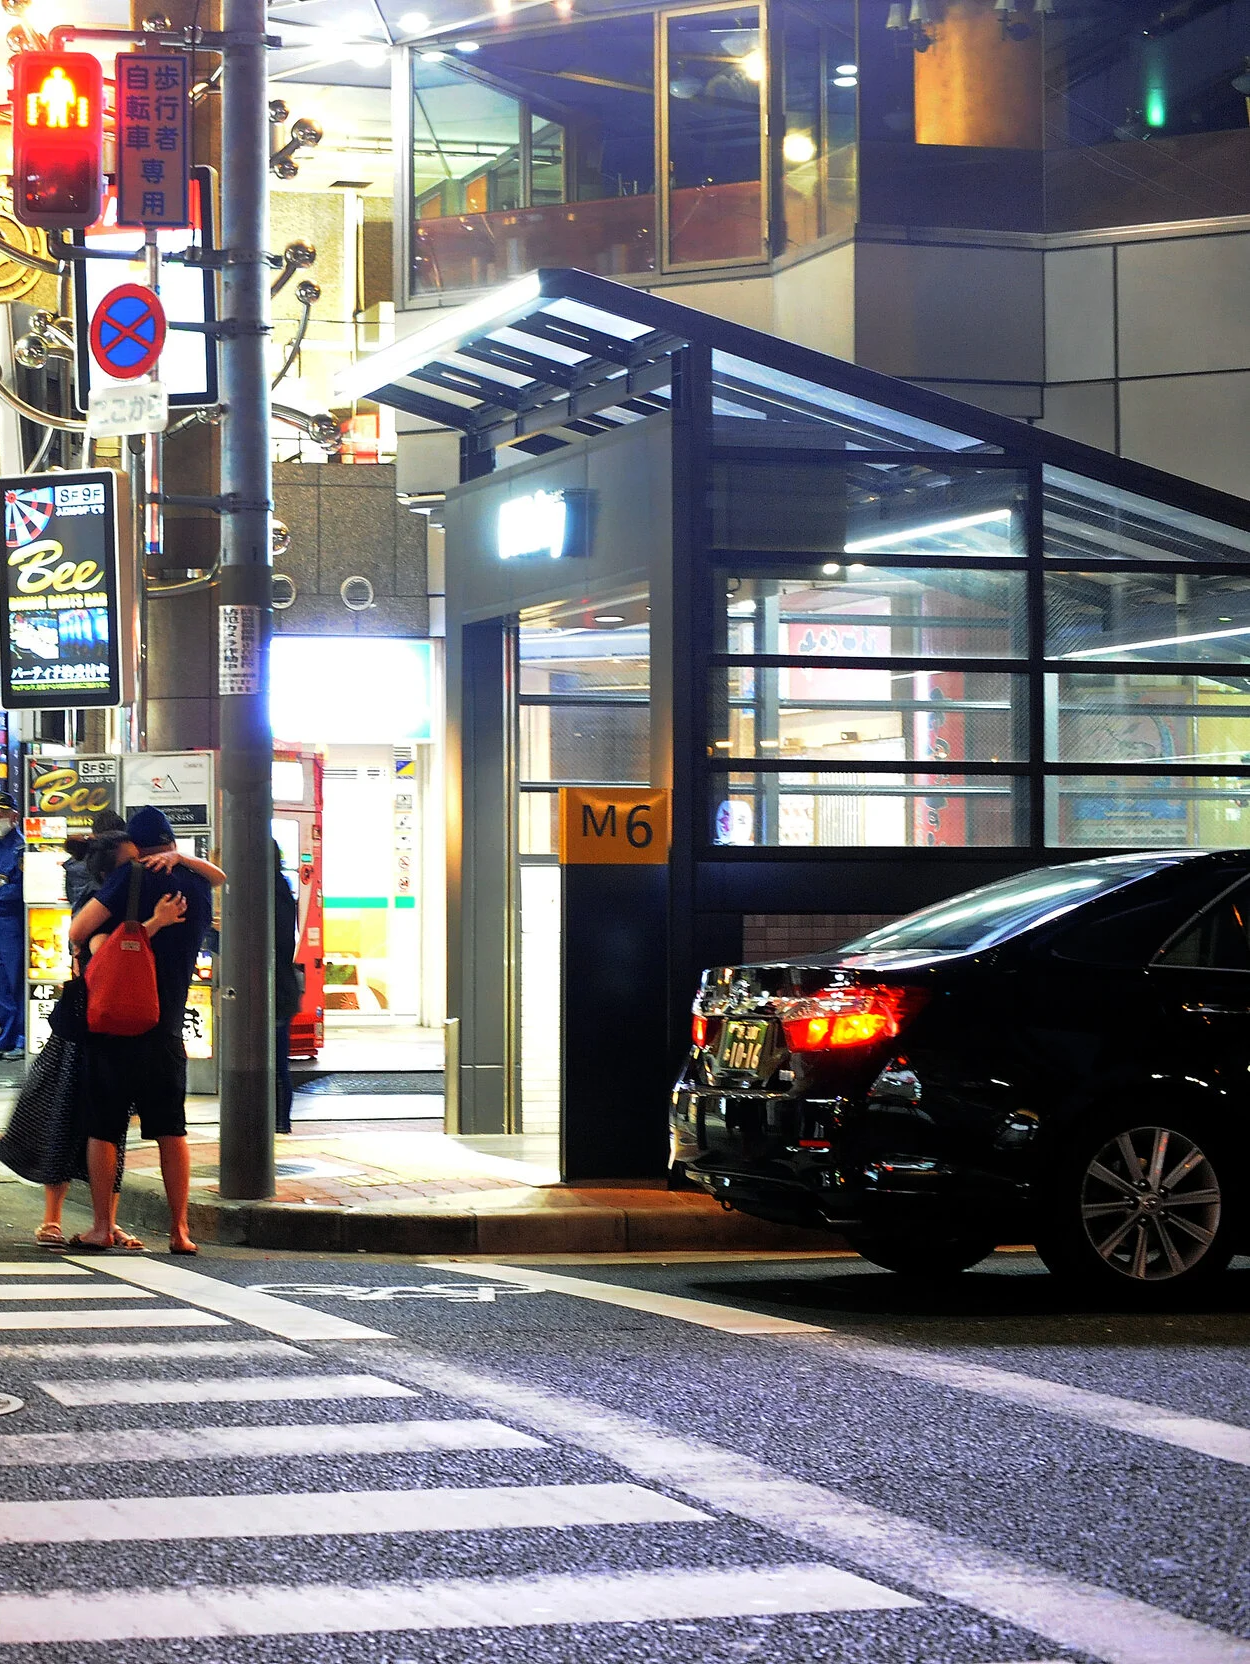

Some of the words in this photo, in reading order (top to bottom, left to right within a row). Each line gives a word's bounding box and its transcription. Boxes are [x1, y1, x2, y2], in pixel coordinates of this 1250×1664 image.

[126, 65, 150, 150] 自転車
[155, 65, 179, 152] 歩行者
[141, 159, 165, 216] 専用
[7, 539, 104, 594] Bee
[33, 769, 110, 812] Bee
[582, 805, 653, 848] M6
[33, 984, 55, 1000] 4F
